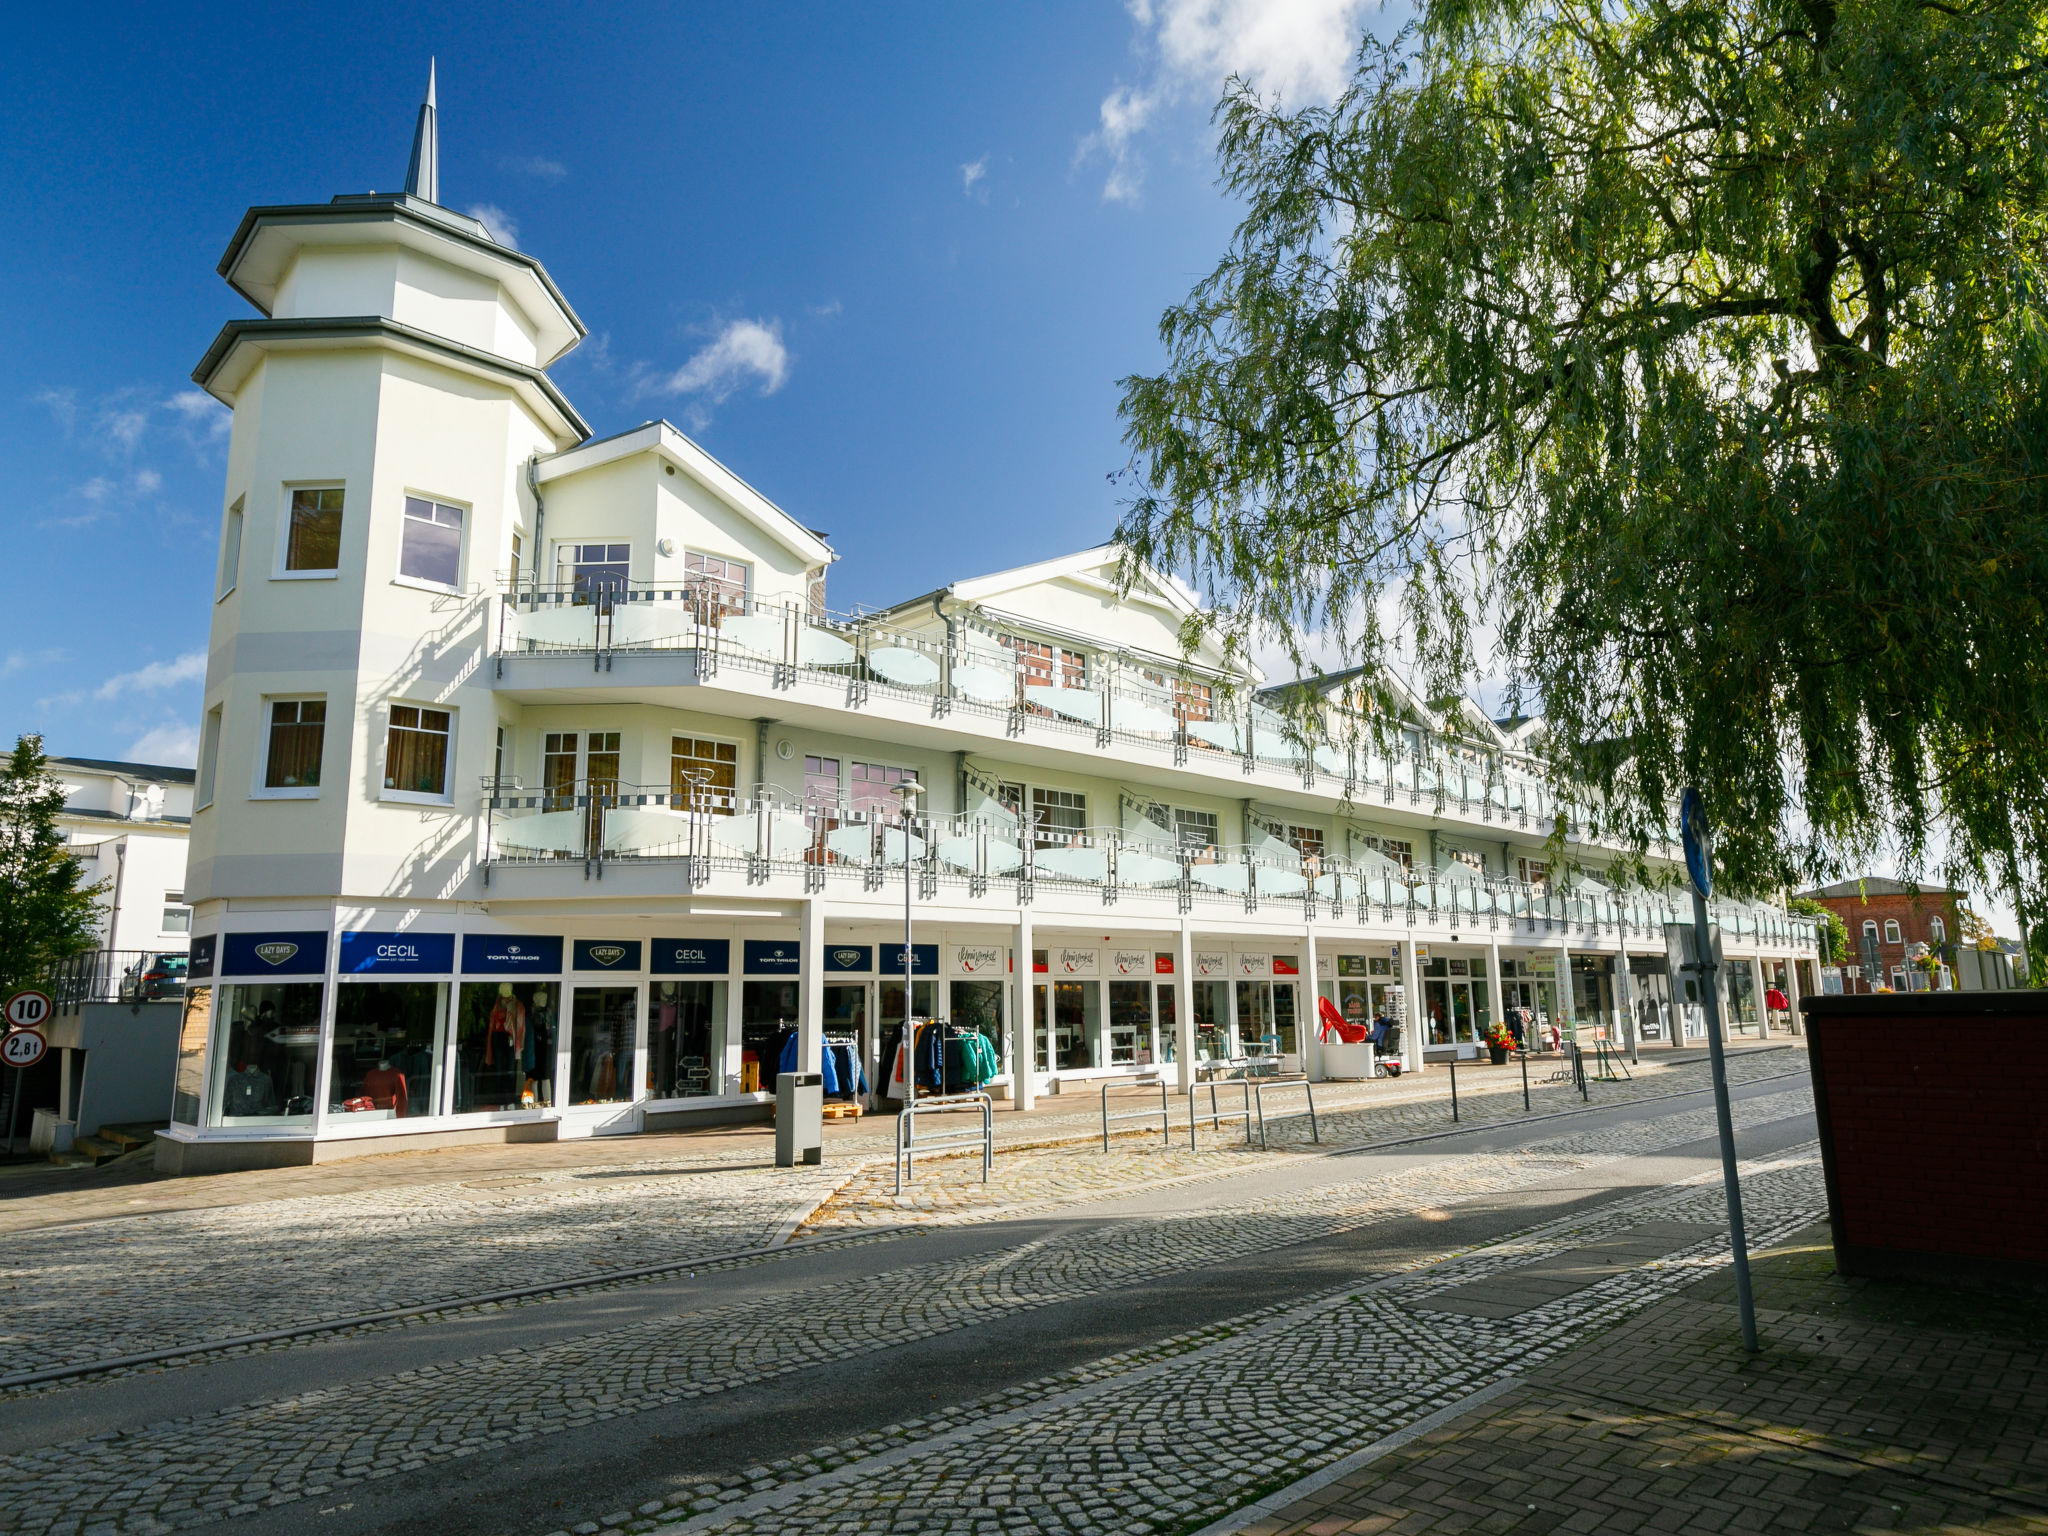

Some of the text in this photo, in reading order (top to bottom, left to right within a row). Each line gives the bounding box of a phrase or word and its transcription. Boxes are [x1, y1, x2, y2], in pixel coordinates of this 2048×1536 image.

[261, 946, 290, 954] LAZY DAYS
[377, 945, 419, 957] CECIL
[675, 949, 706, 960] CECIL
[17, 1000, 41, 1019] 10
[9, 1037, 38, 1057] 2,8 t
